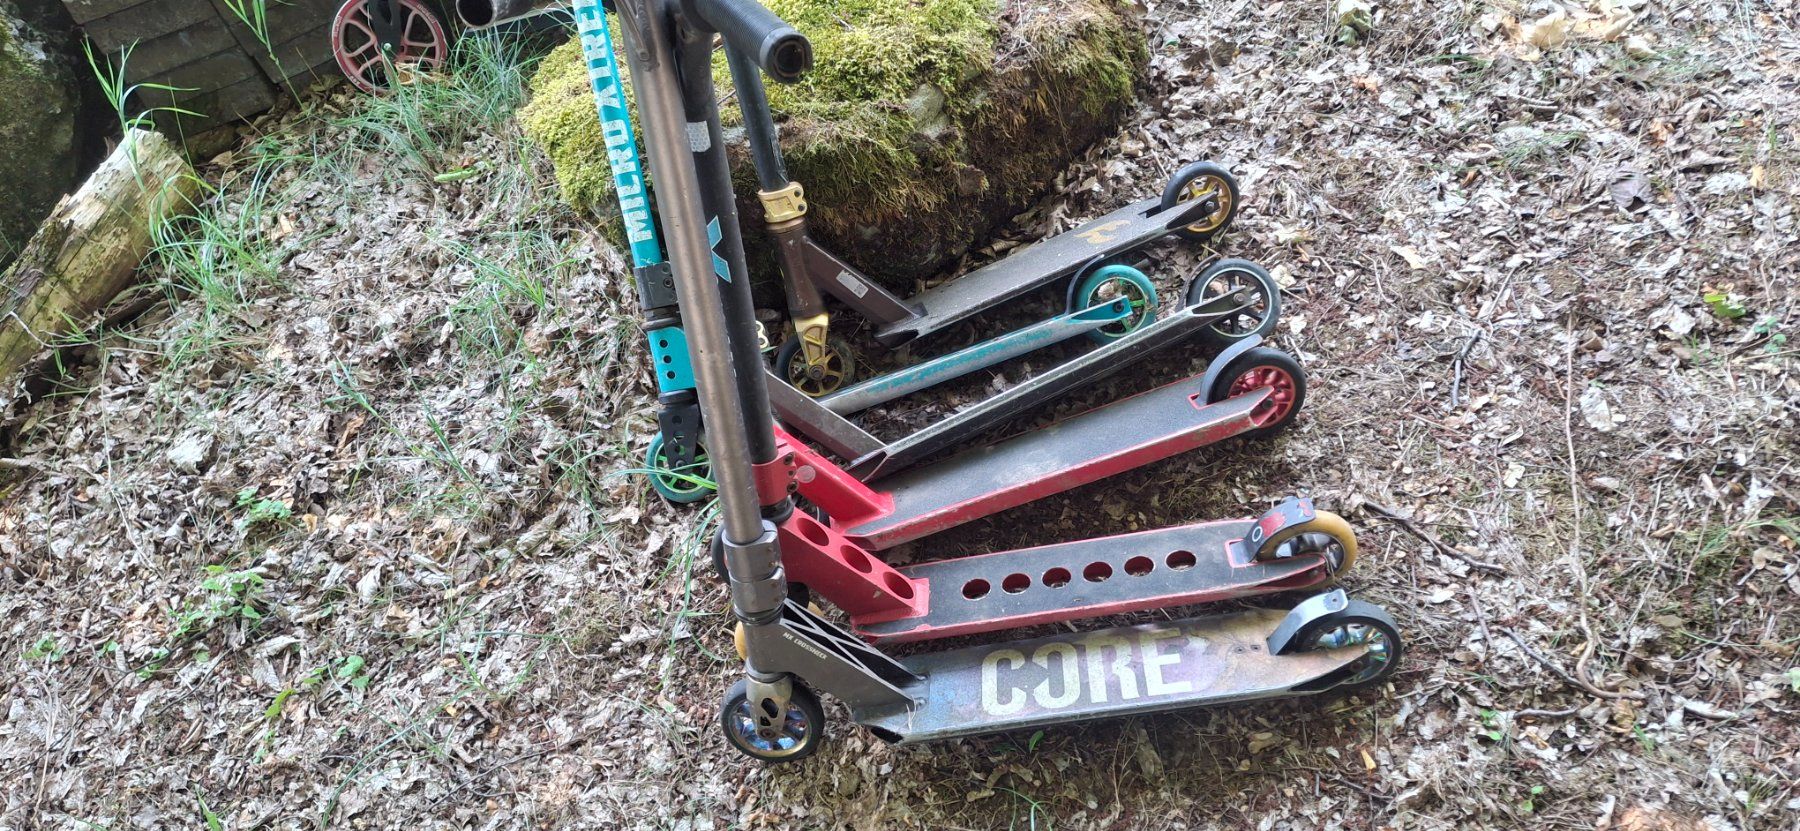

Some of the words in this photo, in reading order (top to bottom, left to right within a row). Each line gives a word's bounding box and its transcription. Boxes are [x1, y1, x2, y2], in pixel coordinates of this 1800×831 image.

[571, 0, 621, 108] XTRE
[602, 119, 653, 243] MICRO
[982, 627, 1193, 716] CORE
